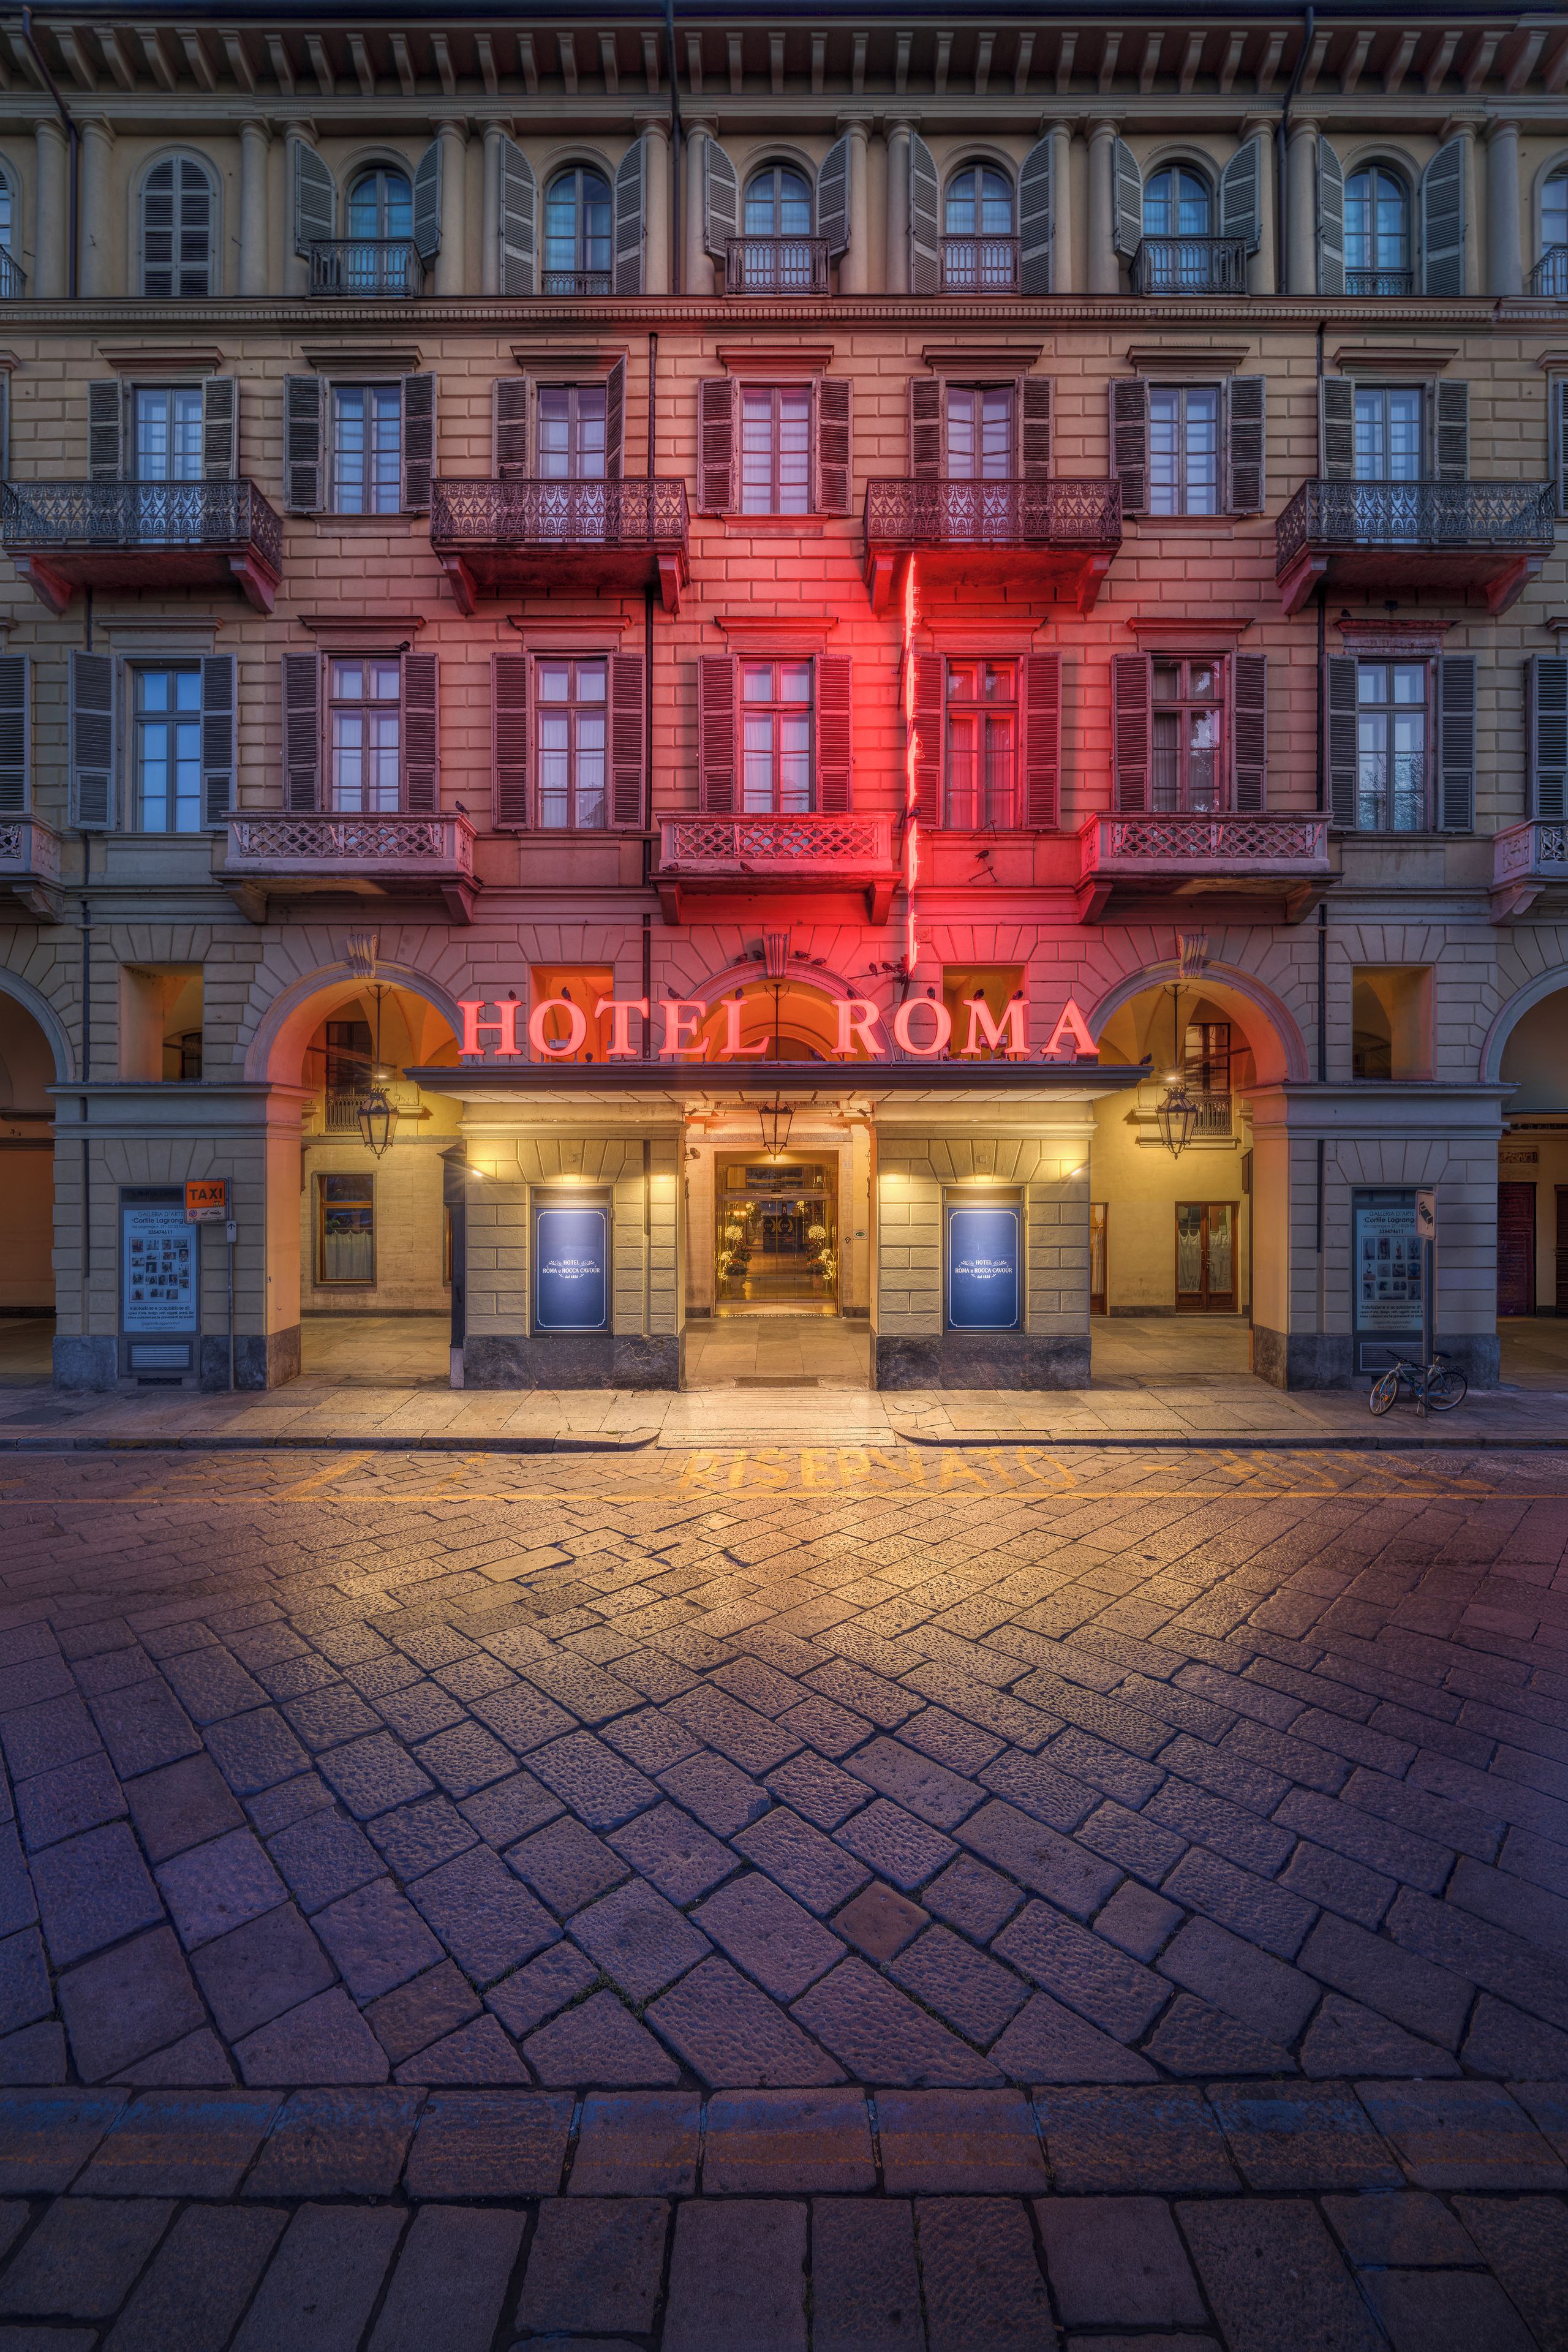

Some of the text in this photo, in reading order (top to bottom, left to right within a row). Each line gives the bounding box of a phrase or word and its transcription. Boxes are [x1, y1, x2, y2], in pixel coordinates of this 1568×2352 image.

[457, 997, 1100, 1057] HOTEL ROMA
[189, 1188, 222, 1200] TAXI
[679, 1447, 1077, 1490] RISERVATO
